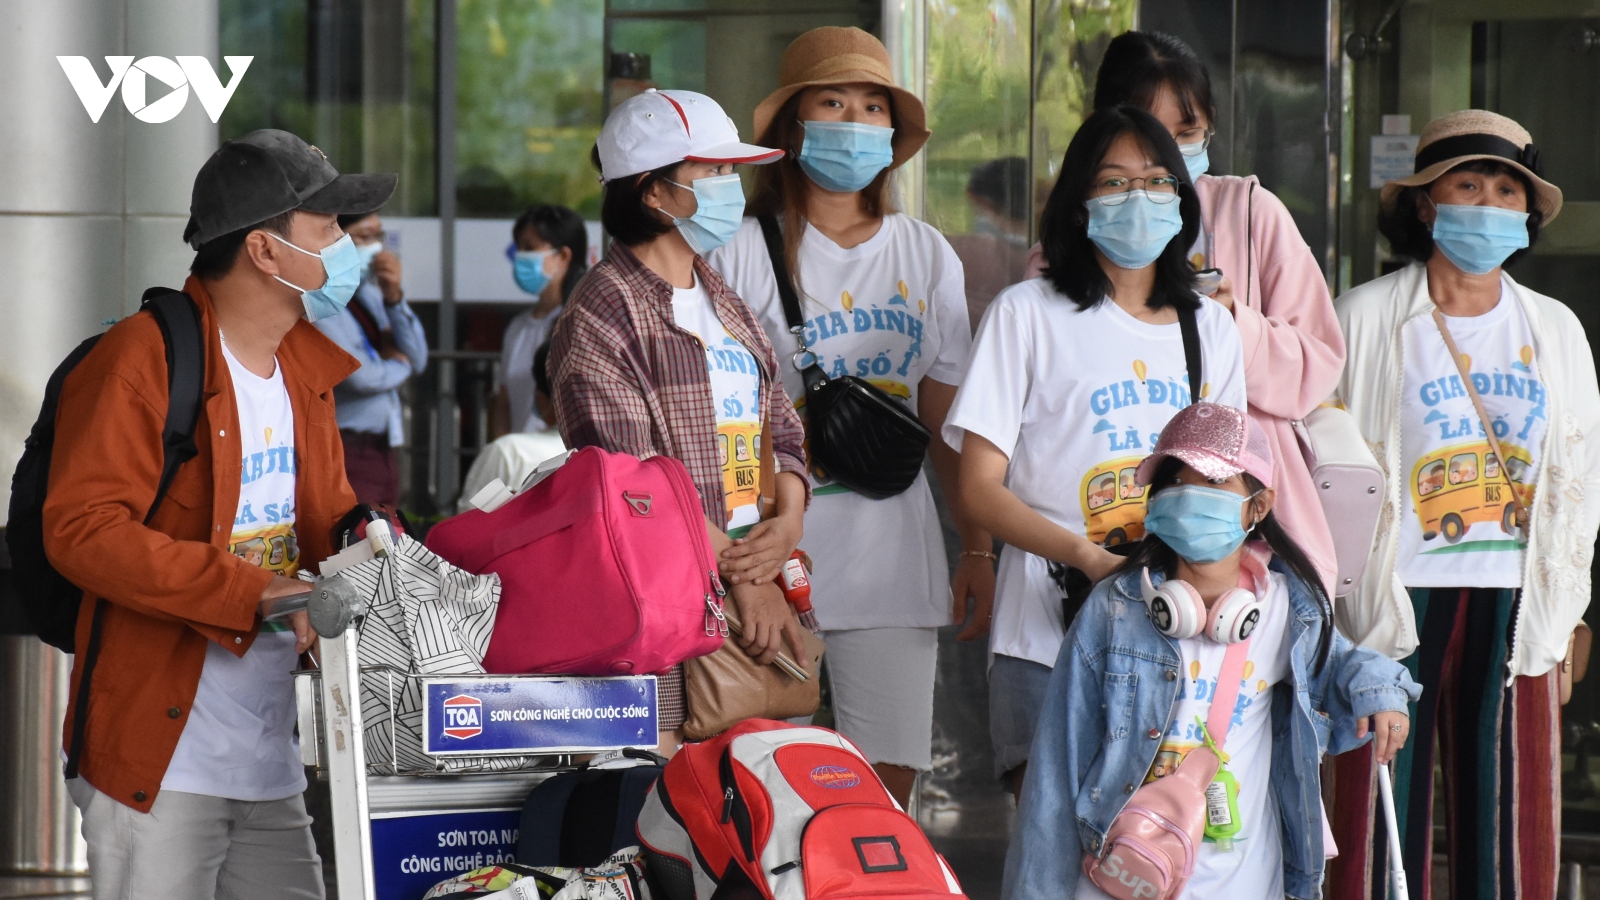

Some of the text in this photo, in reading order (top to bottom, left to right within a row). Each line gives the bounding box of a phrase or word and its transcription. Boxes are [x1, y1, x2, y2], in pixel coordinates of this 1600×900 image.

[802, 304, 924, 348] GIA ĐÌNH
[856, 349, 892, 378] SỐ
[1090, 376, 1192, 416] GIA ĐÌN
[1420, 368, 1546, 408] GIA ĐÌNH
[723, 391, 743, 418] SỐ
[1108, 426, 1142, 452] LÀ
[1440, 415, 1473, 440] LÀ
[736, 469, 754, 487] BUS
[1485, 486, 1501, 502] BUS
[447, 703, 649, 726] TOA SƠN CÔNG NGHỆ CHO CUỘC SỐNG
[438, 829, 519, 847] SƠN TOA NA
[401, 855, 440, 873] CÔNG
[1100, 854, 1157, 899] Sup
